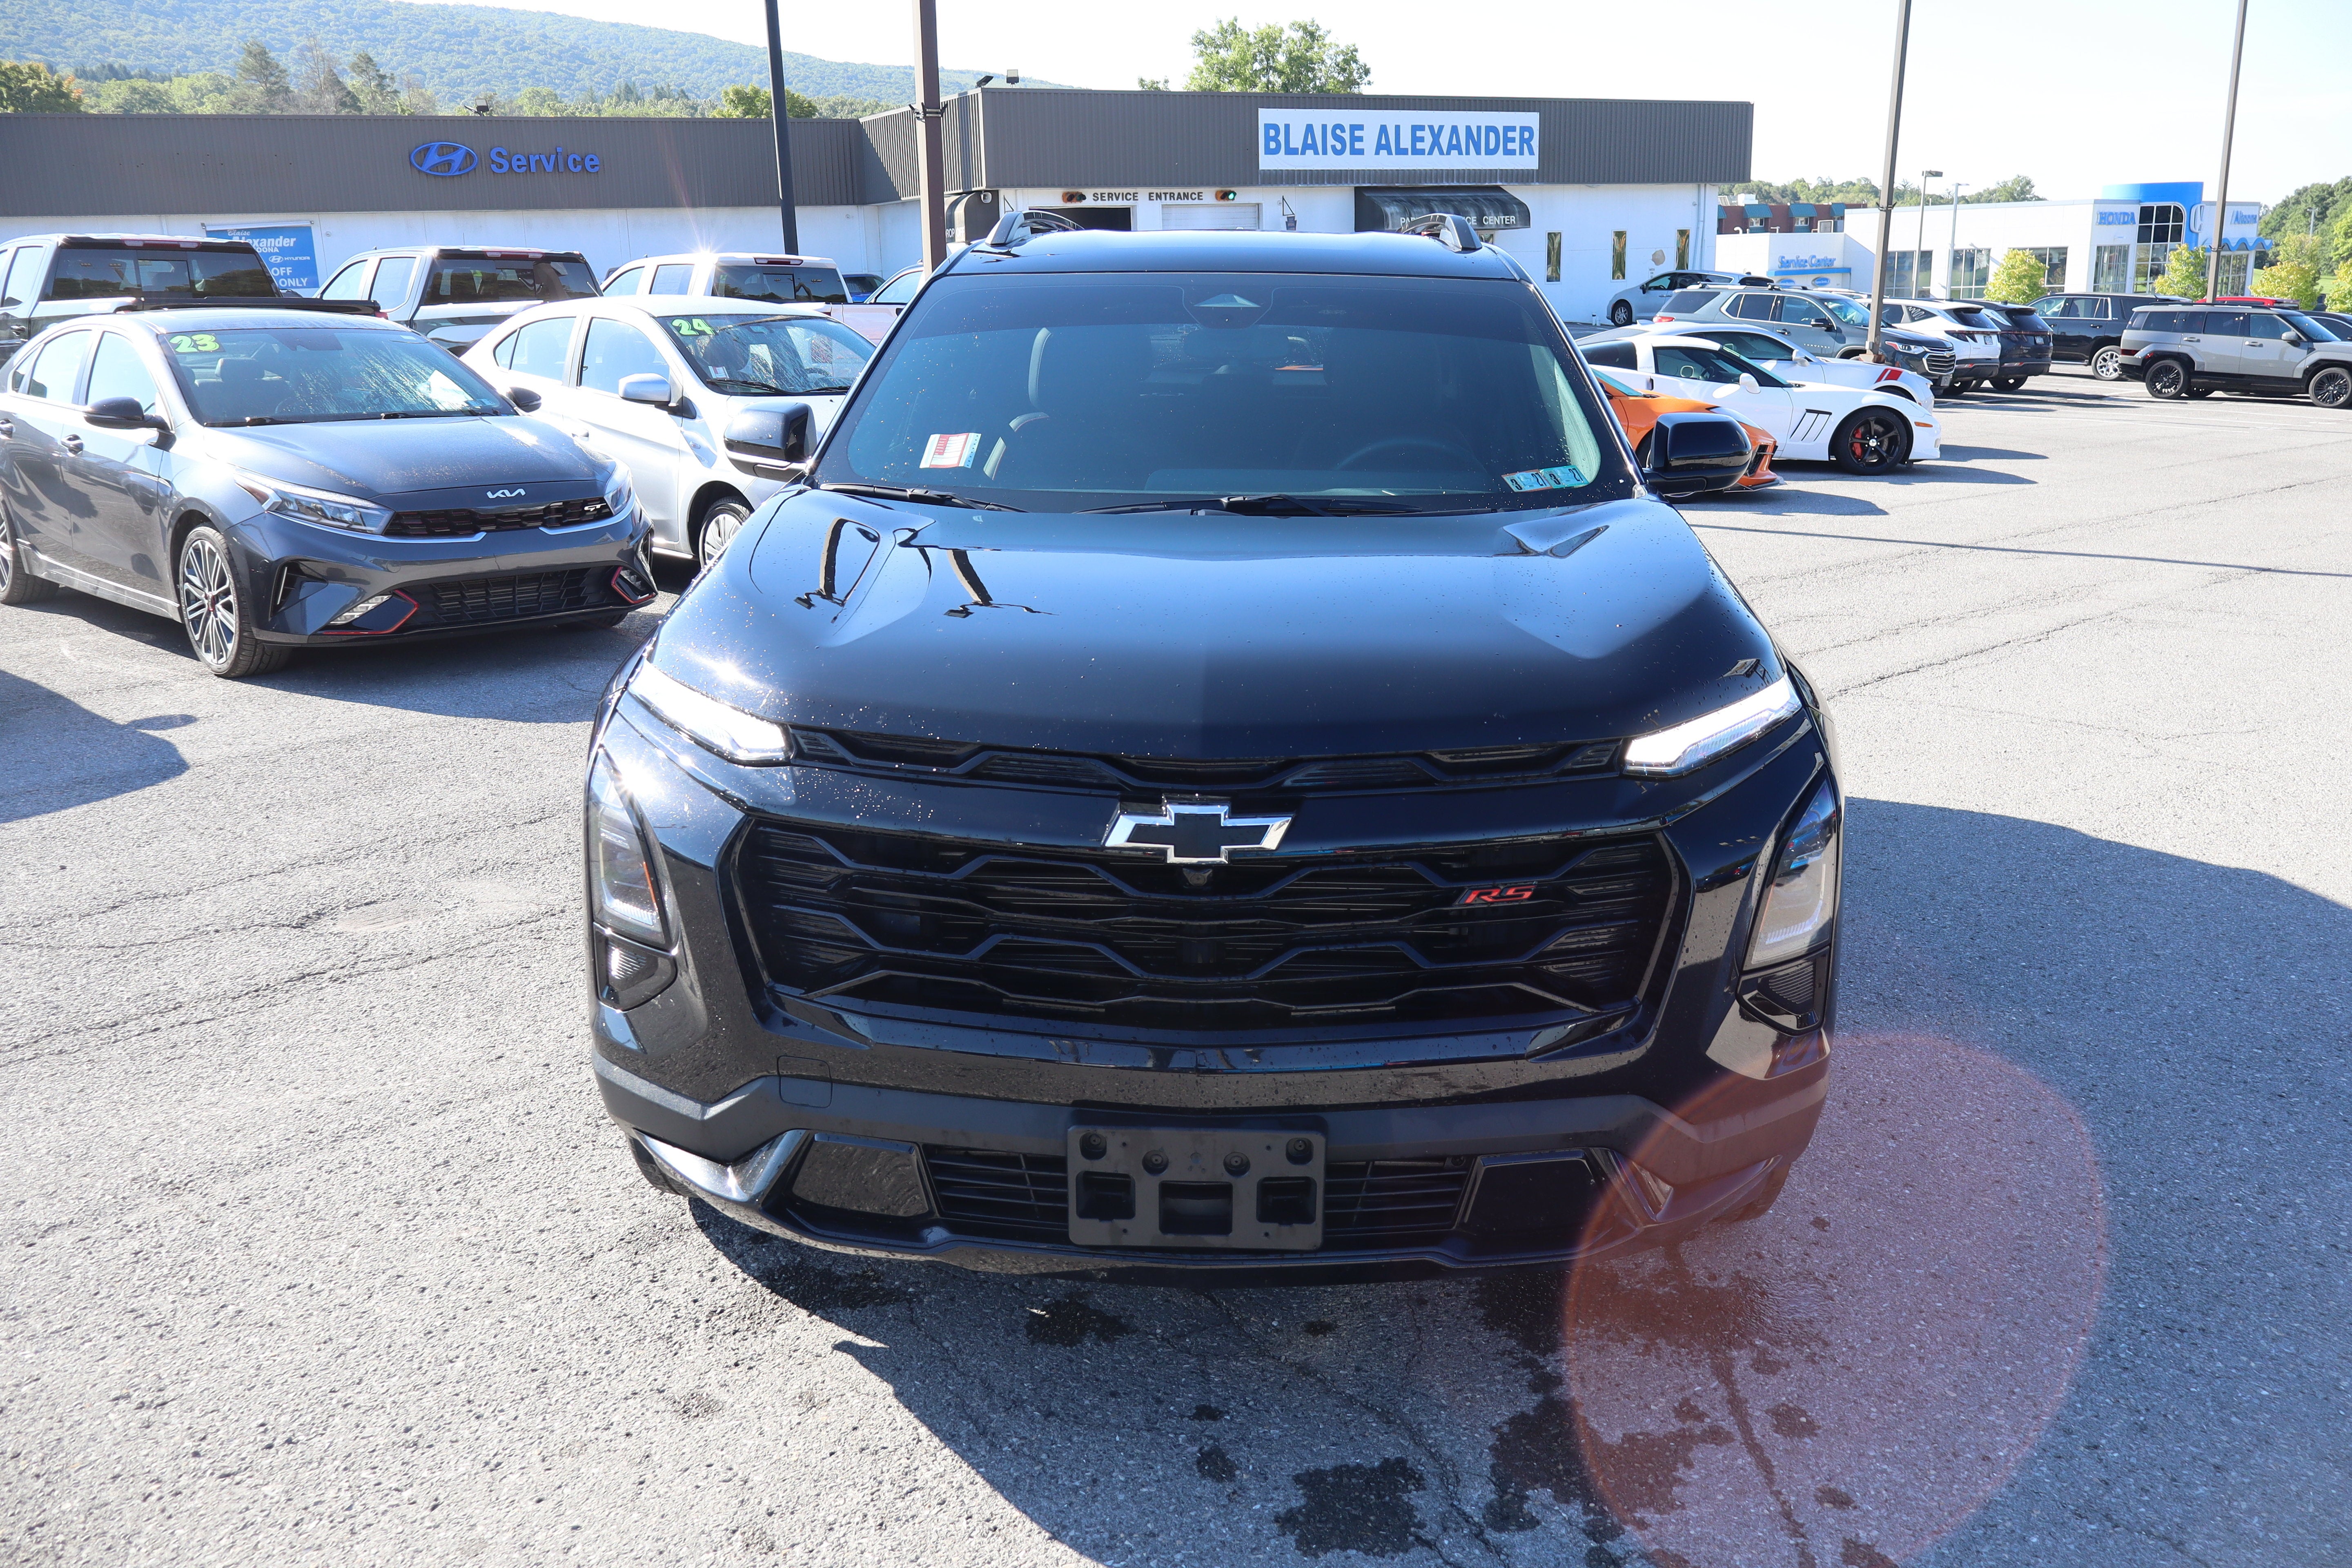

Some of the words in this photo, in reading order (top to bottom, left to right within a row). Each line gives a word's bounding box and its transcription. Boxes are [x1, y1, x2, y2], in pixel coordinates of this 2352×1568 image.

[1264, 123, 1365, 156] BLAISE
[1374, 124, 1535, 156] ALEXANDER
[490, 147, 600, 174] Service
[1093, 192, 1138, 201] SERVICE
[1148, 192, 1203, 200] ENTRANCE
[1483, 216, 1515, 225] CENTER
[2096, 212, 2136, 225] HONDA
[945, 228, 955, 238] ROP
[1778, 256, 1808, 268] Service
[1808, 255, 1836, 267] Center
[271, 267, 292, 276] OFF
[279, 278, 308, 287] ONLY
[672, 318, 715, 336] 24
[169, 333, 220, 353] 23
[1510, 479, 1523, 490] 3
[1531, 472, 1547, 486] 27
[1549, 474, 1561, 485] 3
[1568, 468, 1584, 481] 27
[584, 503, 606, 512] GT
[1463, 885, 1536, 904] RS
